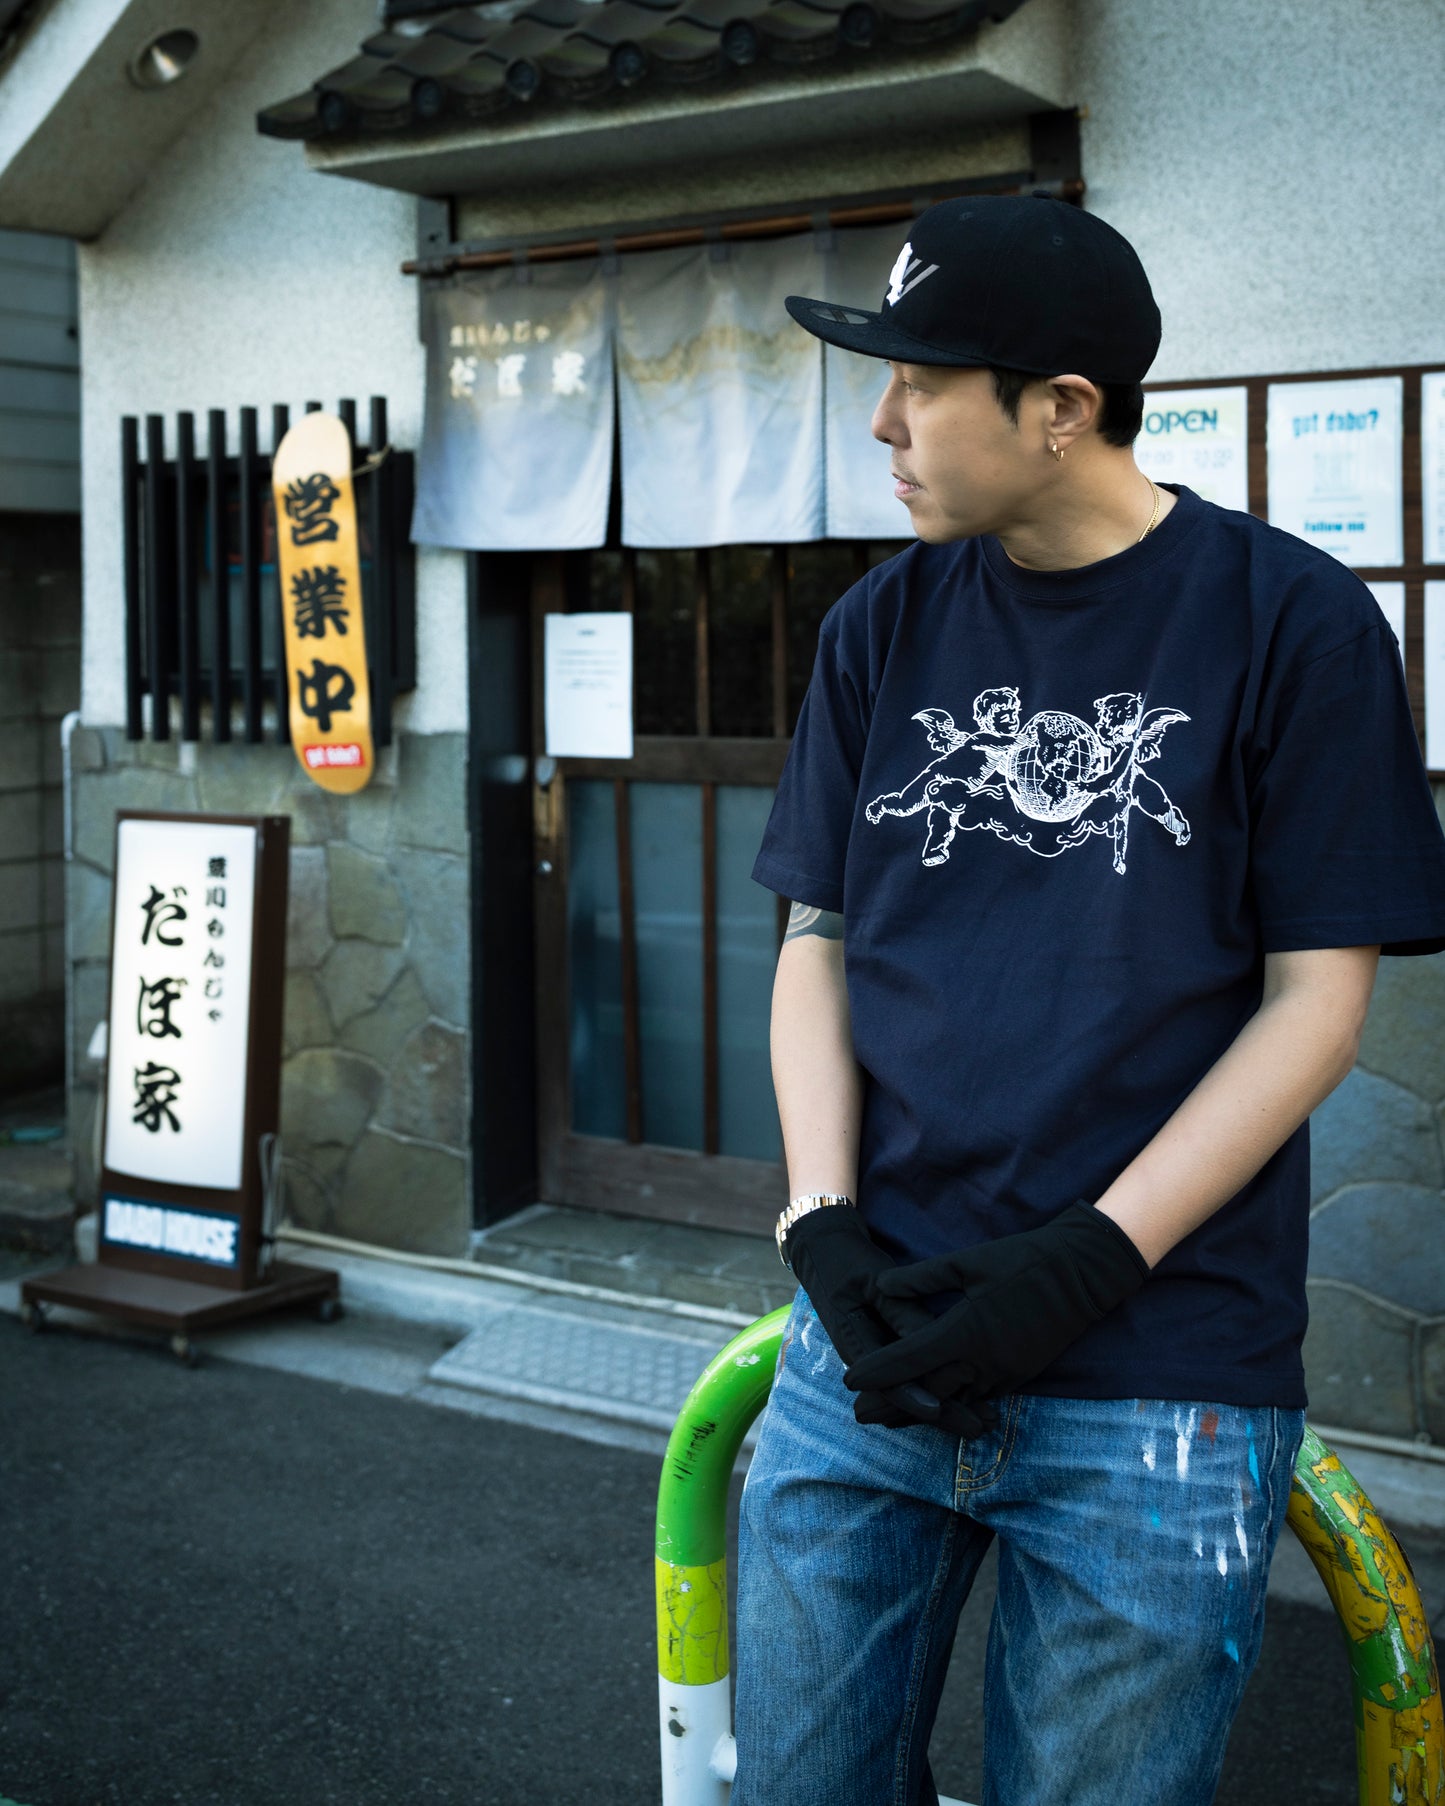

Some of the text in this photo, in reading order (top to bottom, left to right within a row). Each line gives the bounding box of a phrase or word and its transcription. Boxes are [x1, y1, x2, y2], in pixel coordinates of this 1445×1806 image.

[1145, 408, 1218, 434] OPEN
[284, 472, 356, 733] 営業中
[132, 884, 189, 1135] だぼ家
